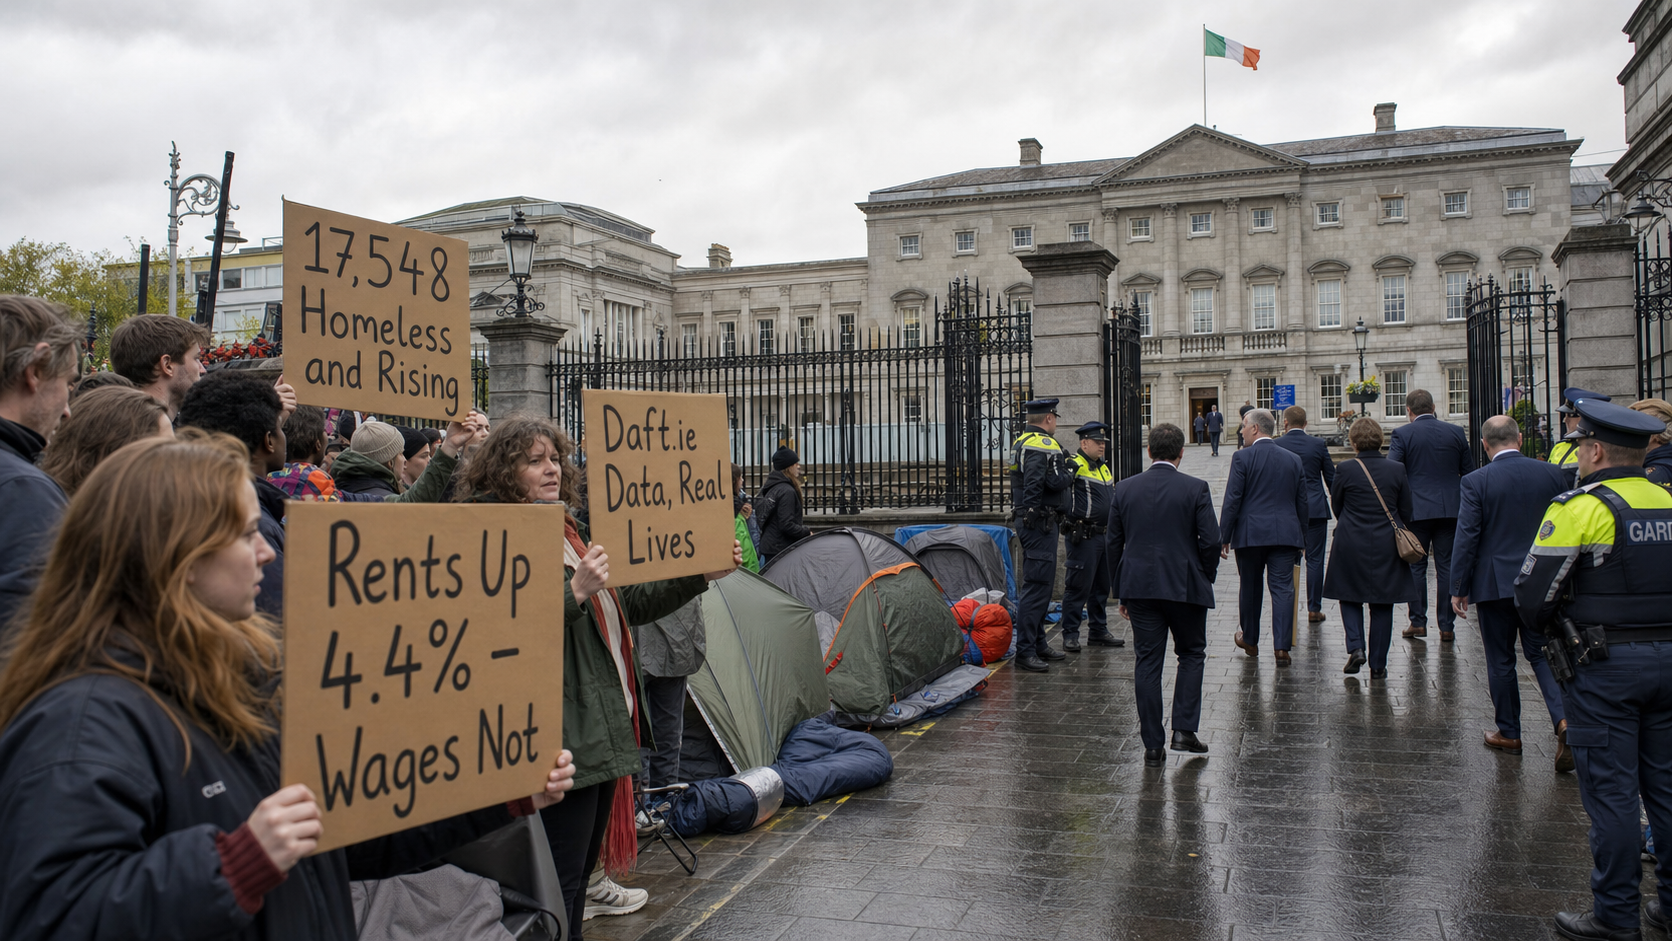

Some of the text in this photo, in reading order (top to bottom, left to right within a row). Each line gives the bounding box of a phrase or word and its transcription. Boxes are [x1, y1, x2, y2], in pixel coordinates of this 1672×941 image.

[304, 221, 450, 303] 17,548
[300, 284, 452, 355] Homeless
[304, 349, 459, 417] and Rising
[602, 404, 698, 453] Daft.ie
[605, 459, 727, 513] Data, Real
[327, 519, 531, 619] Rents Up
[628, 518, 695, 566] Lives
[319, 617, 472, 710] 4.4%
[315, 702, 539, 819] Wages Not
